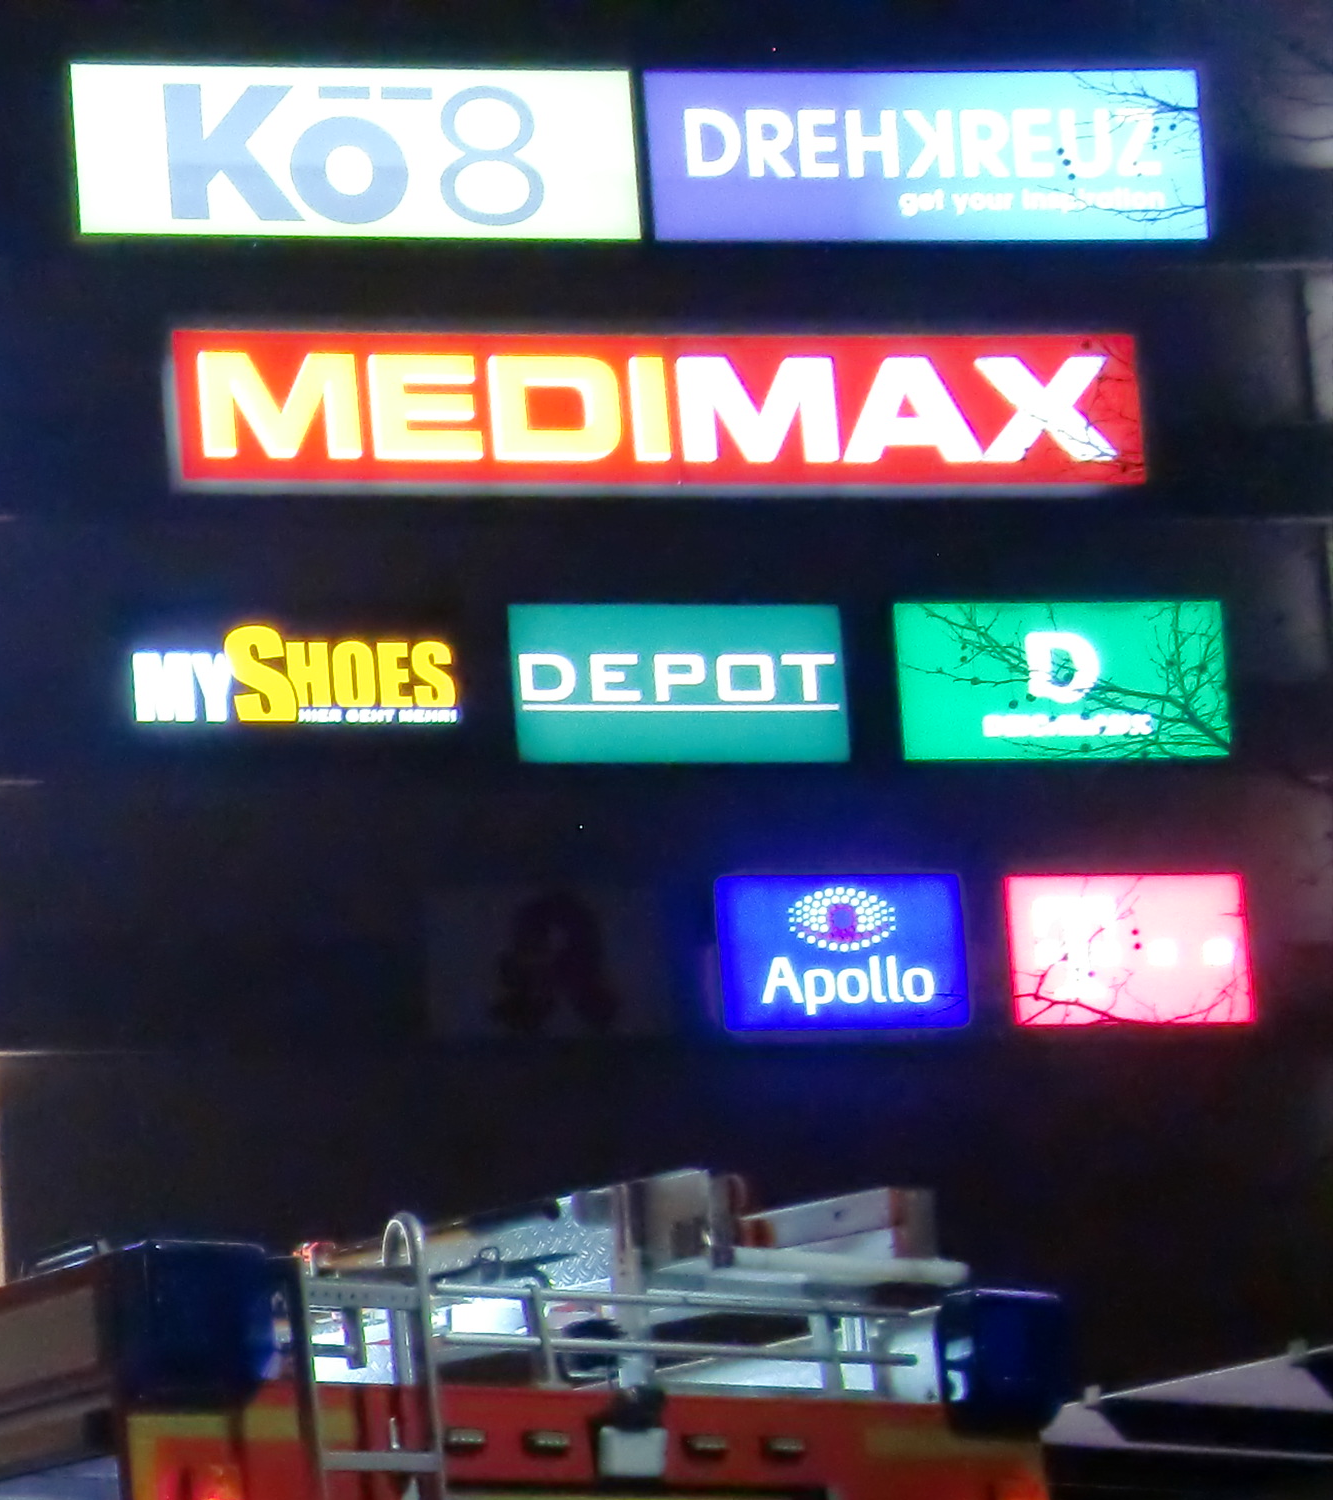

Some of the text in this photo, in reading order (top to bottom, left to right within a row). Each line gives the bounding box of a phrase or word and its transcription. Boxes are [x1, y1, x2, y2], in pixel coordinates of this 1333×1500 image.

[683, 107, 1162, 179] DREHKREUZ
[951, 193, 1014, 216] your
[196, 350, 1117, 464] MEDIMAX
[518, 653, 837, 703] DEPOT
[1024, 631, 1101, 705] D
[761, 954, 936, 1016] Apollo
